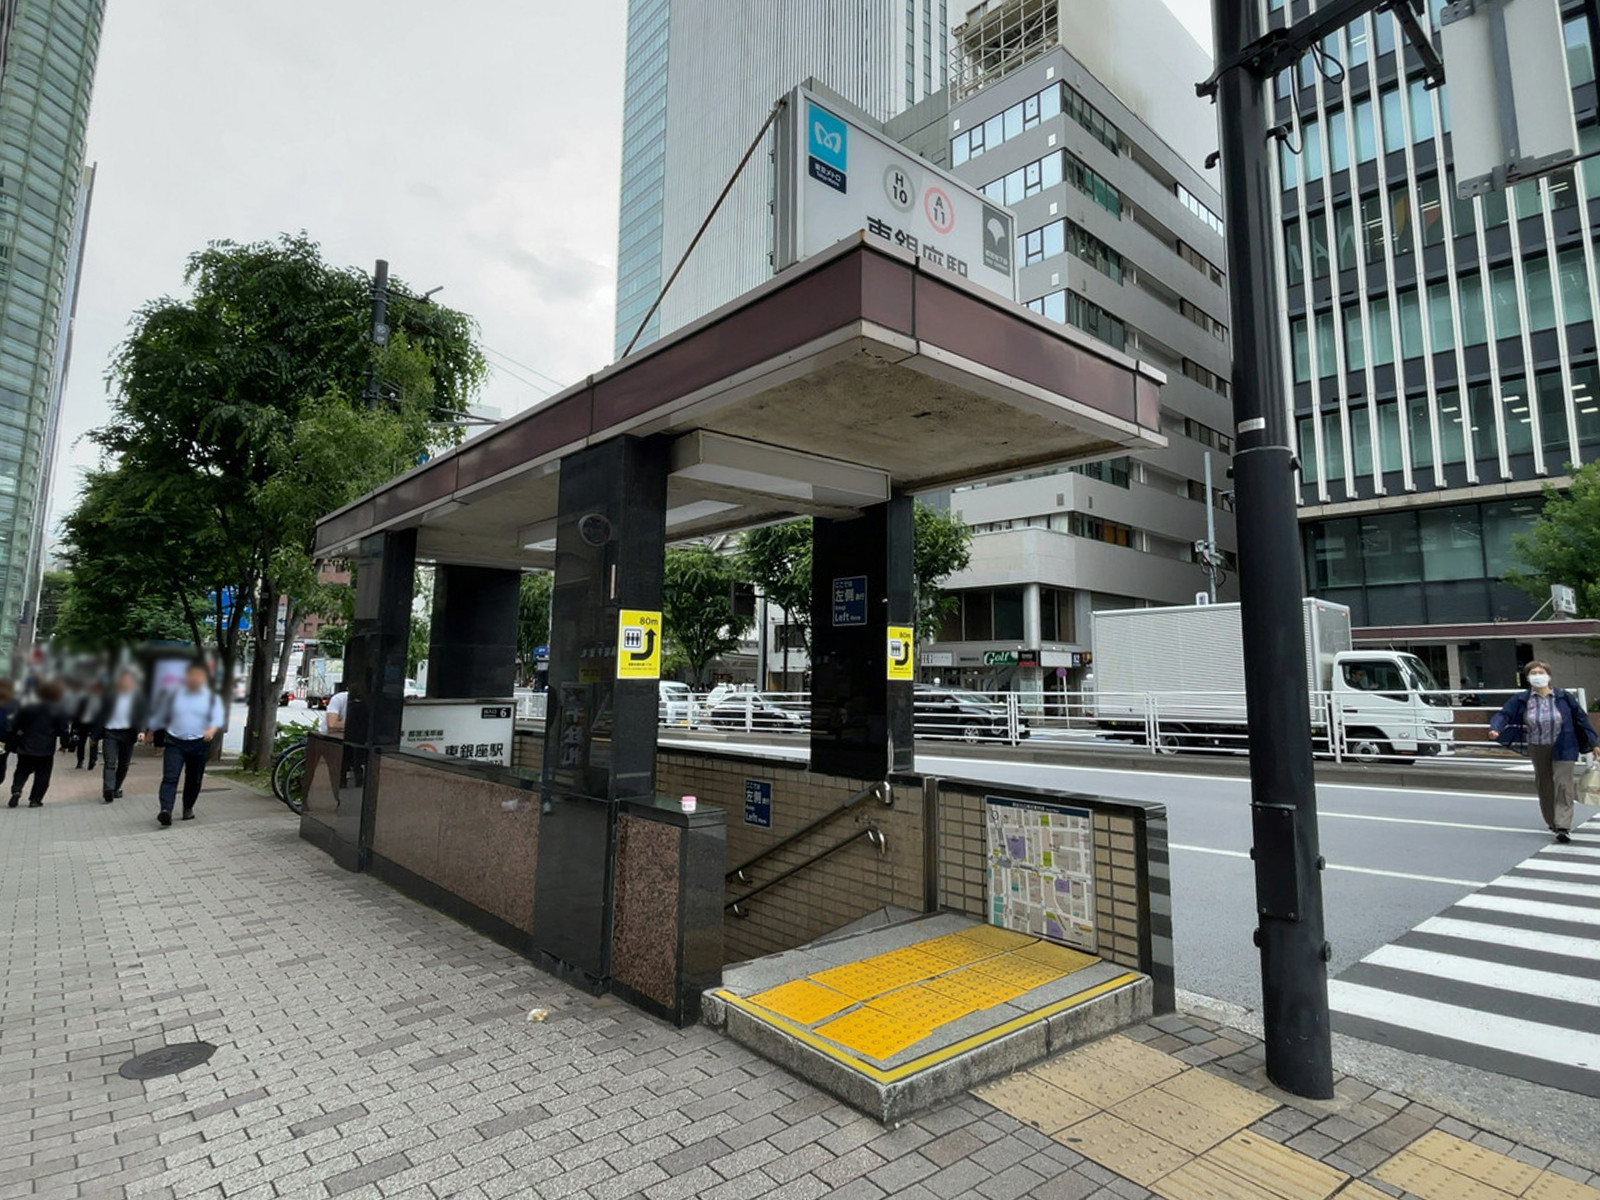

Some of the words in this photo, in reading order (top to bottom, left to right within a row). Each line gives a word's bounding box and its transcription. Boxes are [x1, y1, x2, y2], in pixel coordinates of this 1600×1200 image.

[895, 172, 904, 188] H
[893, 185, 908, 204] 10
[936, 195, 944, 209] A
[933, 207, 945, 225] 11
[640, 617, 659, 626] 80m
[984, 652, 1010, 666] Golf
[500, 708, 507, 718] 6
